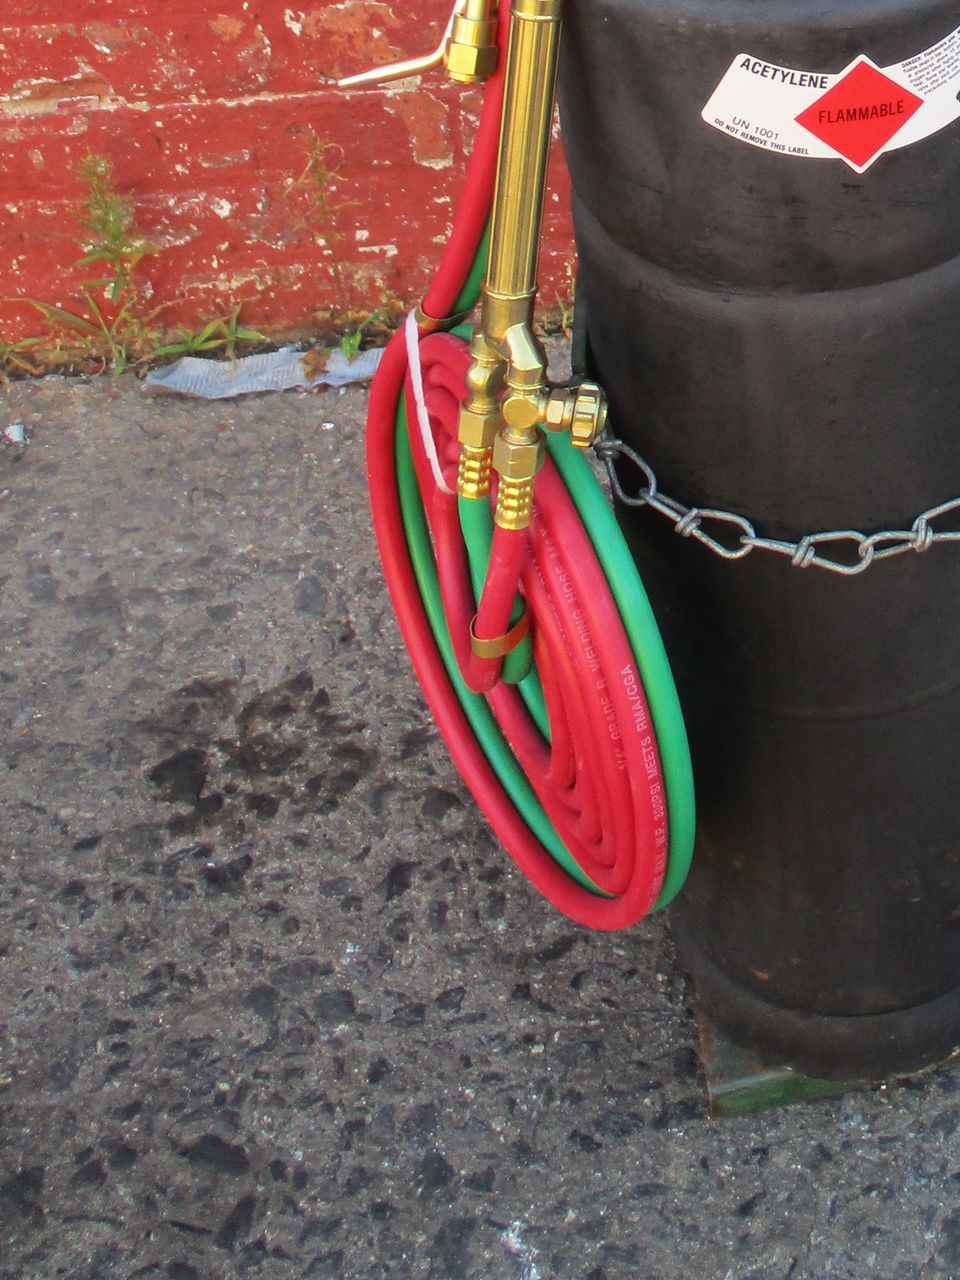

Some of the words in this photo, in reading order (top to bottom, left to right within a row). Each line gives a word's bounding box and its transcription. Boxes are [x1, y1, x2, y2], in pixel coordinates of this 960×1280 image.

[739, 58, 829, 90] ACETYLENE
[732, 115, 751, 130] UN
[754, 125, 780, 141] 1001
[818, 100, 905, 124] FLAMMABLE
[714, 117, 724, 127] DO
[725, 123, 740, 135] NOT
[740, 130, 768, 147] REMOVE
[770, 141, 787, 152] THIS
[787, 145, 810, 156] LABEL
[620, 663, 648, 733] RMA/CGA
[641, 735, 658, 779] MEETS
